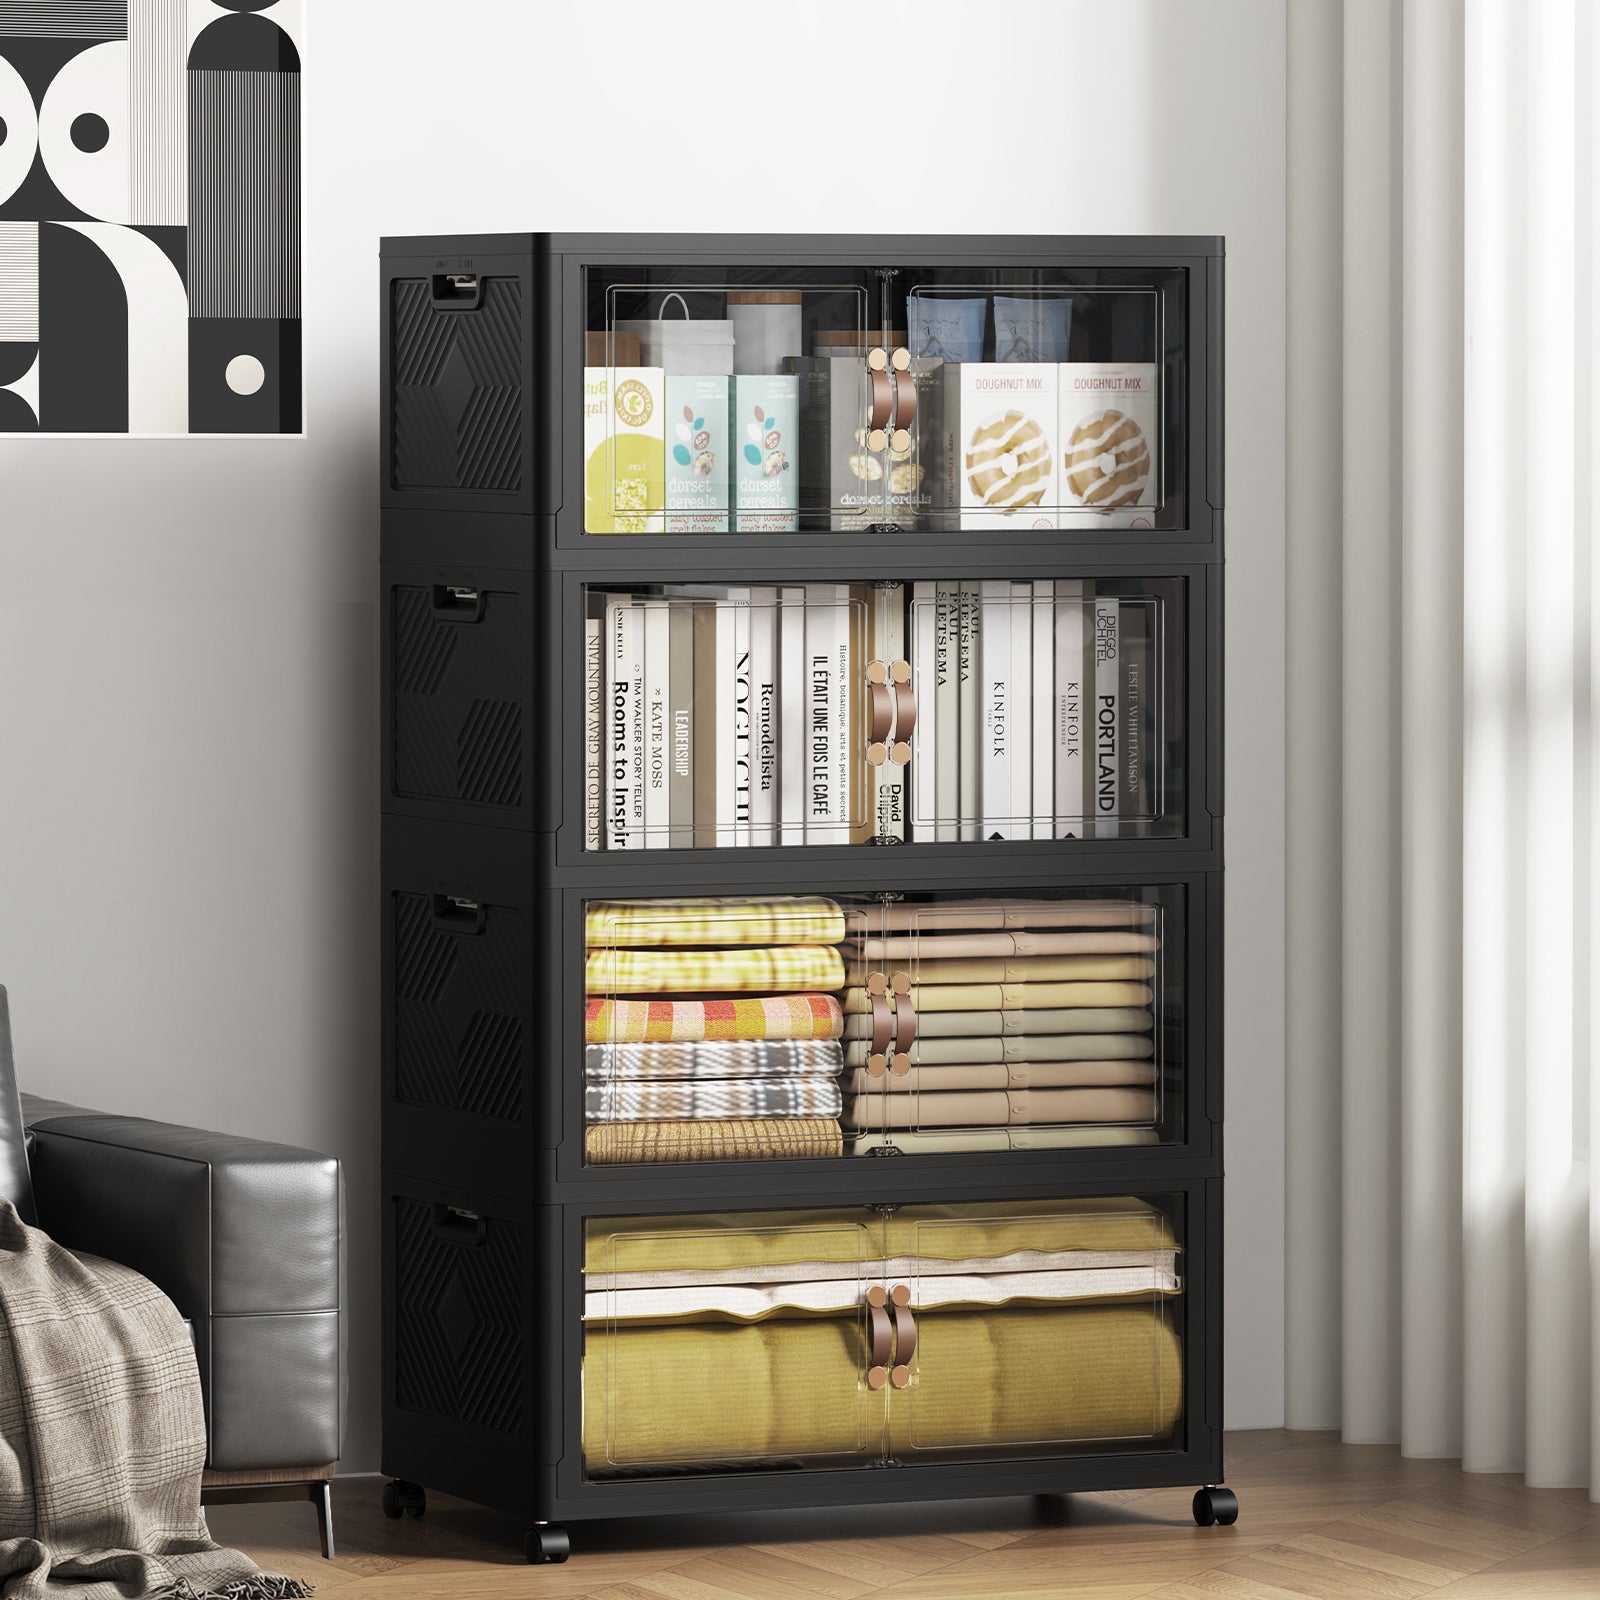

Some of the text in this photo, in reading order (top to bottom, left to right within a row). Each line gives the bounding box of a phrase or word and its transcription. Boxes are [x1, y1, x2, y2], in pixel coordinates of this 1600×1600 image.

[975, 378, 1043, 390] DOUGHNUT MIX
[1074, 378, 1142, 390] DOUGHNUT MIX
[668, 479, 712, 493] dorset
[668, 495, 717, 508] cereals
[740, 479, 783, 493] dorset
[740, 495, 788, 508] cereals
[616, 632, 624, 660] KELLY
[937, 591, 947, 688] SIETSEMA
[949, 592, 958, 641] PAUL
[961, 591, 969, 683] SIETSEMA
[971, 592, 979, 639] PAUL
[1096, 608, 1107, 668] UCHITEL
[1106, 615, 1116, 660] DIEGO
[1128, 663, 1138, 703] LESLIE
[588, 634, 600, 844] SECRETO DE GRAY MOUNTAIN
[634, 677, 642, 818] TIM WALKER STORY TELLER
[651, 701, 663, 789] KATE MOSS
[675, 710, 689, 777] LEADERSHIP
[761, 682, 775, 791] Remodelista
[813, 655, 831, 816] IL ÉTAIT UNE FOIS LE CAFÉ
[838, 644, 847, 823] Histoire, botanique, arts et petits secrets
[993, 681, 1004, 758] KINFOLK
[1067, 681, 1078, 758] KINFOLK
[609, 681, 629, 850] Rooms to Inspir
[1098, 694, 1115, 812] PORTLAND
[891, 784, 902, 822] David
